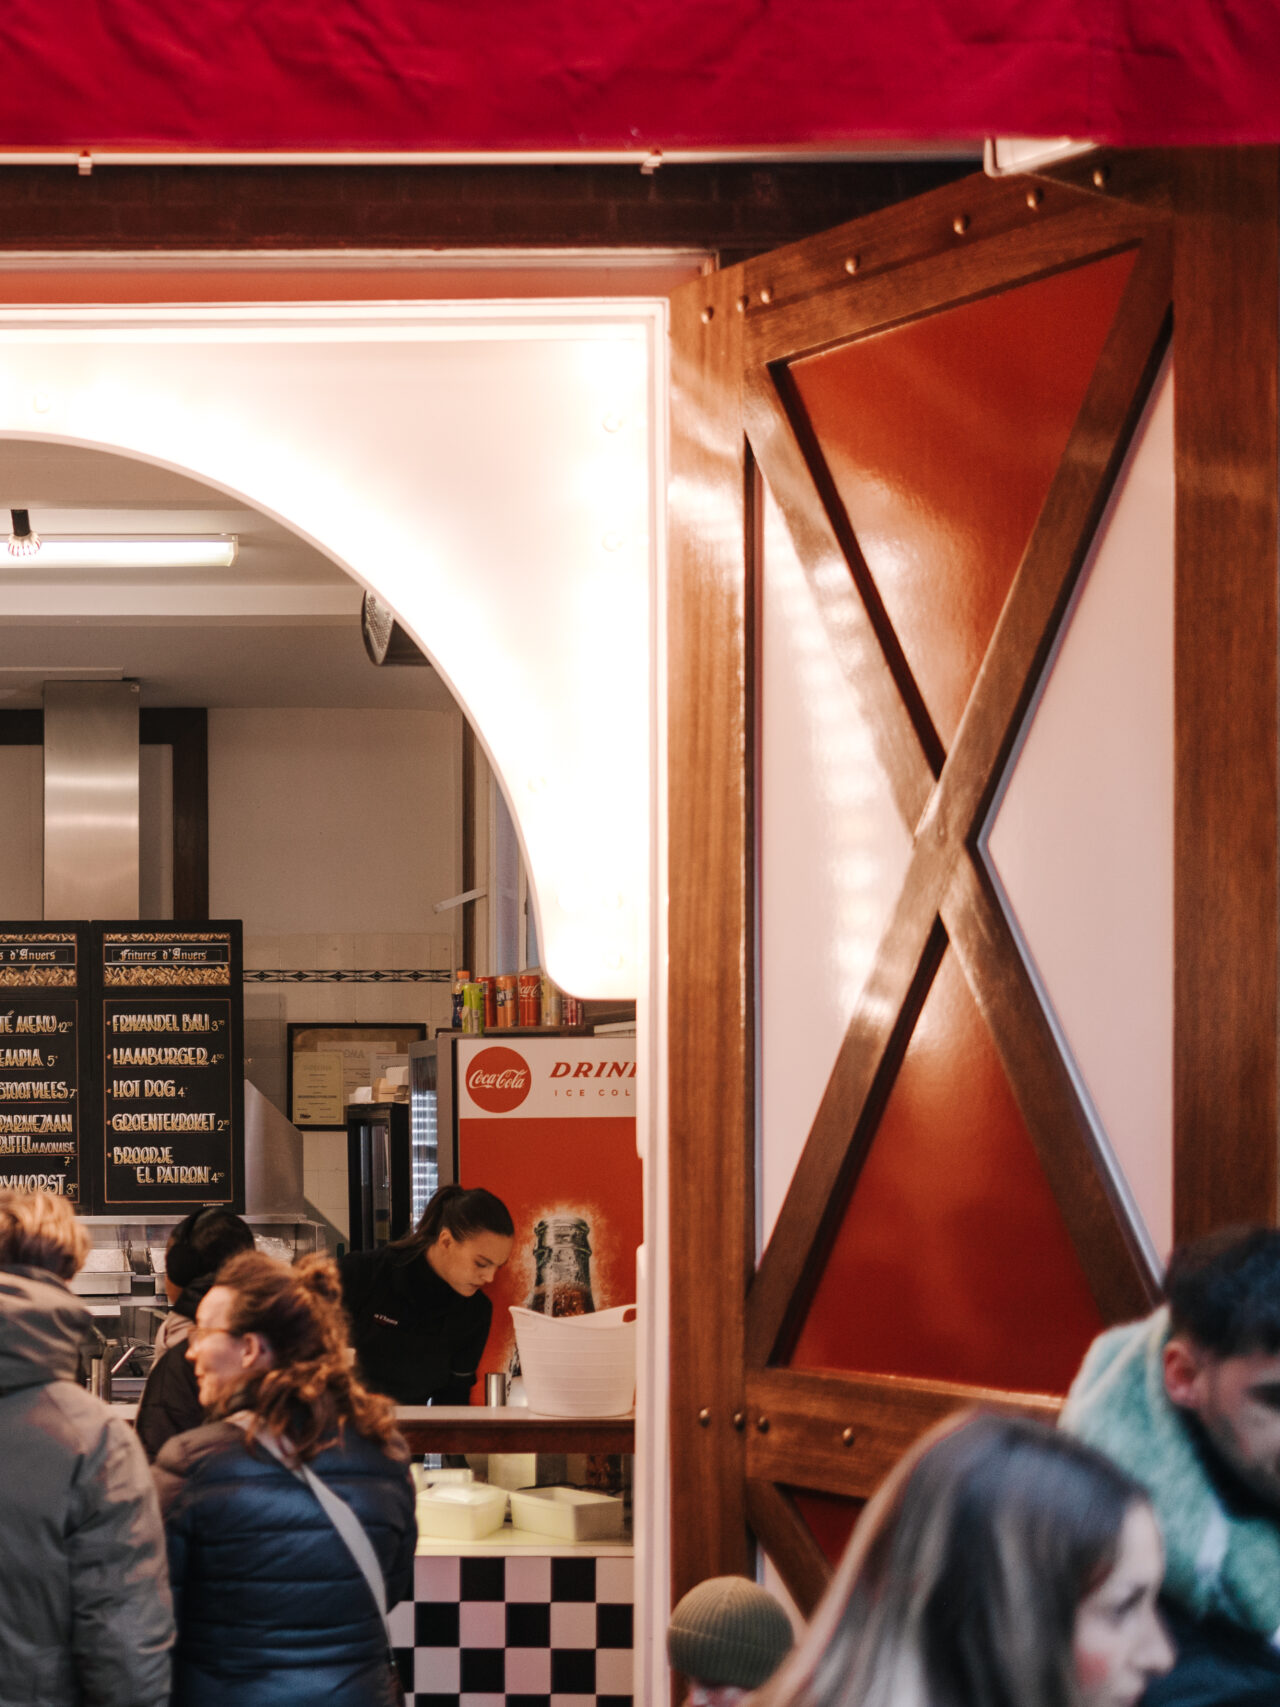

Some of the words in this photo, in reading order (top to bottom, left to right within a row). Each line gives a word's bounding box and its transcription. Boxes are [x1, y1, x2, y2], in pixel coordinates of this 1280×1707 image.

[119, 948, 157, 962] Fritures
[15, 1015, 57, 1034] MENU
[112, 1014, 180, 1032] FRIKANDEL
[182, 1013, 210, 1032] BALI
[112, 1047, 209, 1066] HAMBURGER
[469, 1068, 528, 1089] Coca-Cola
[113, 1080, 141, 1098] HOT
[144, 1079, 176, 1097] DOG
[554, 1089, 585, 1097] ICE
[598, 1088, 631, 1097] COL
[111, 1113, 216, 1132] GROENTEKROKET
[112, 1146, 174, 1164] BROODJE
